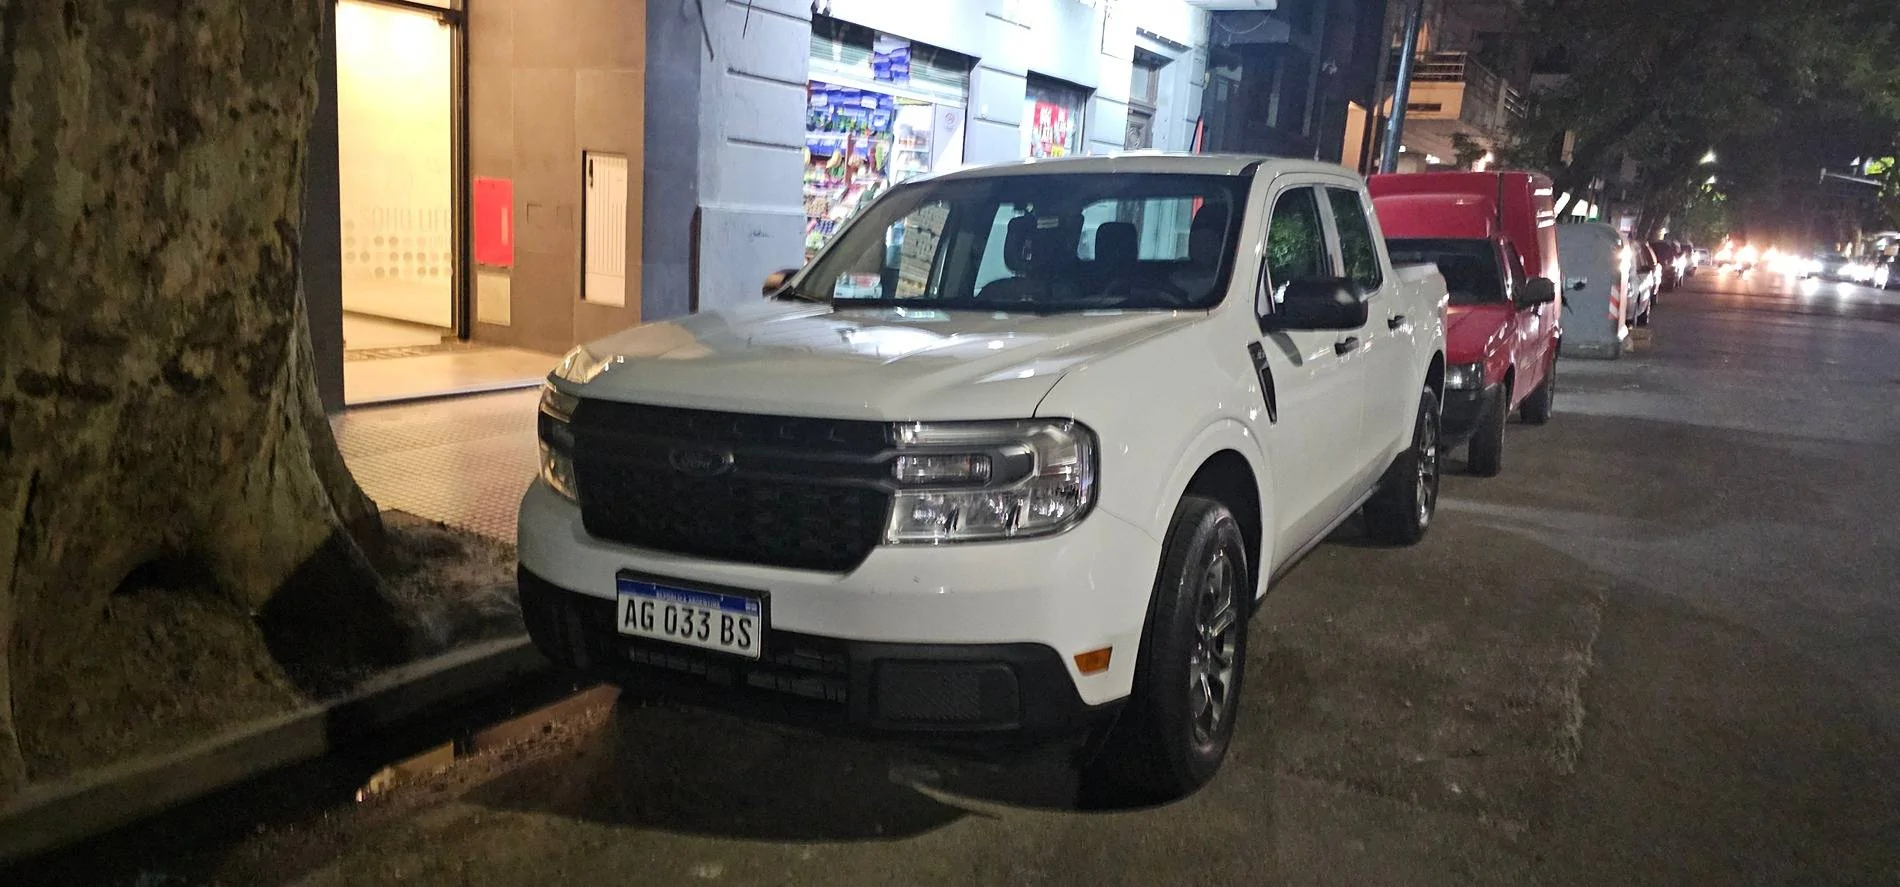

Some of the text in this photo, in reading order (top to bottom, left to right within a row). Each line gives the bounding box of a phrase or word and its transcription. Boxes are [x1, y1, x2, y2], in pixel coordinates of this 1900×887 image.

[624, 598, 752, 650] AG 033 BS
